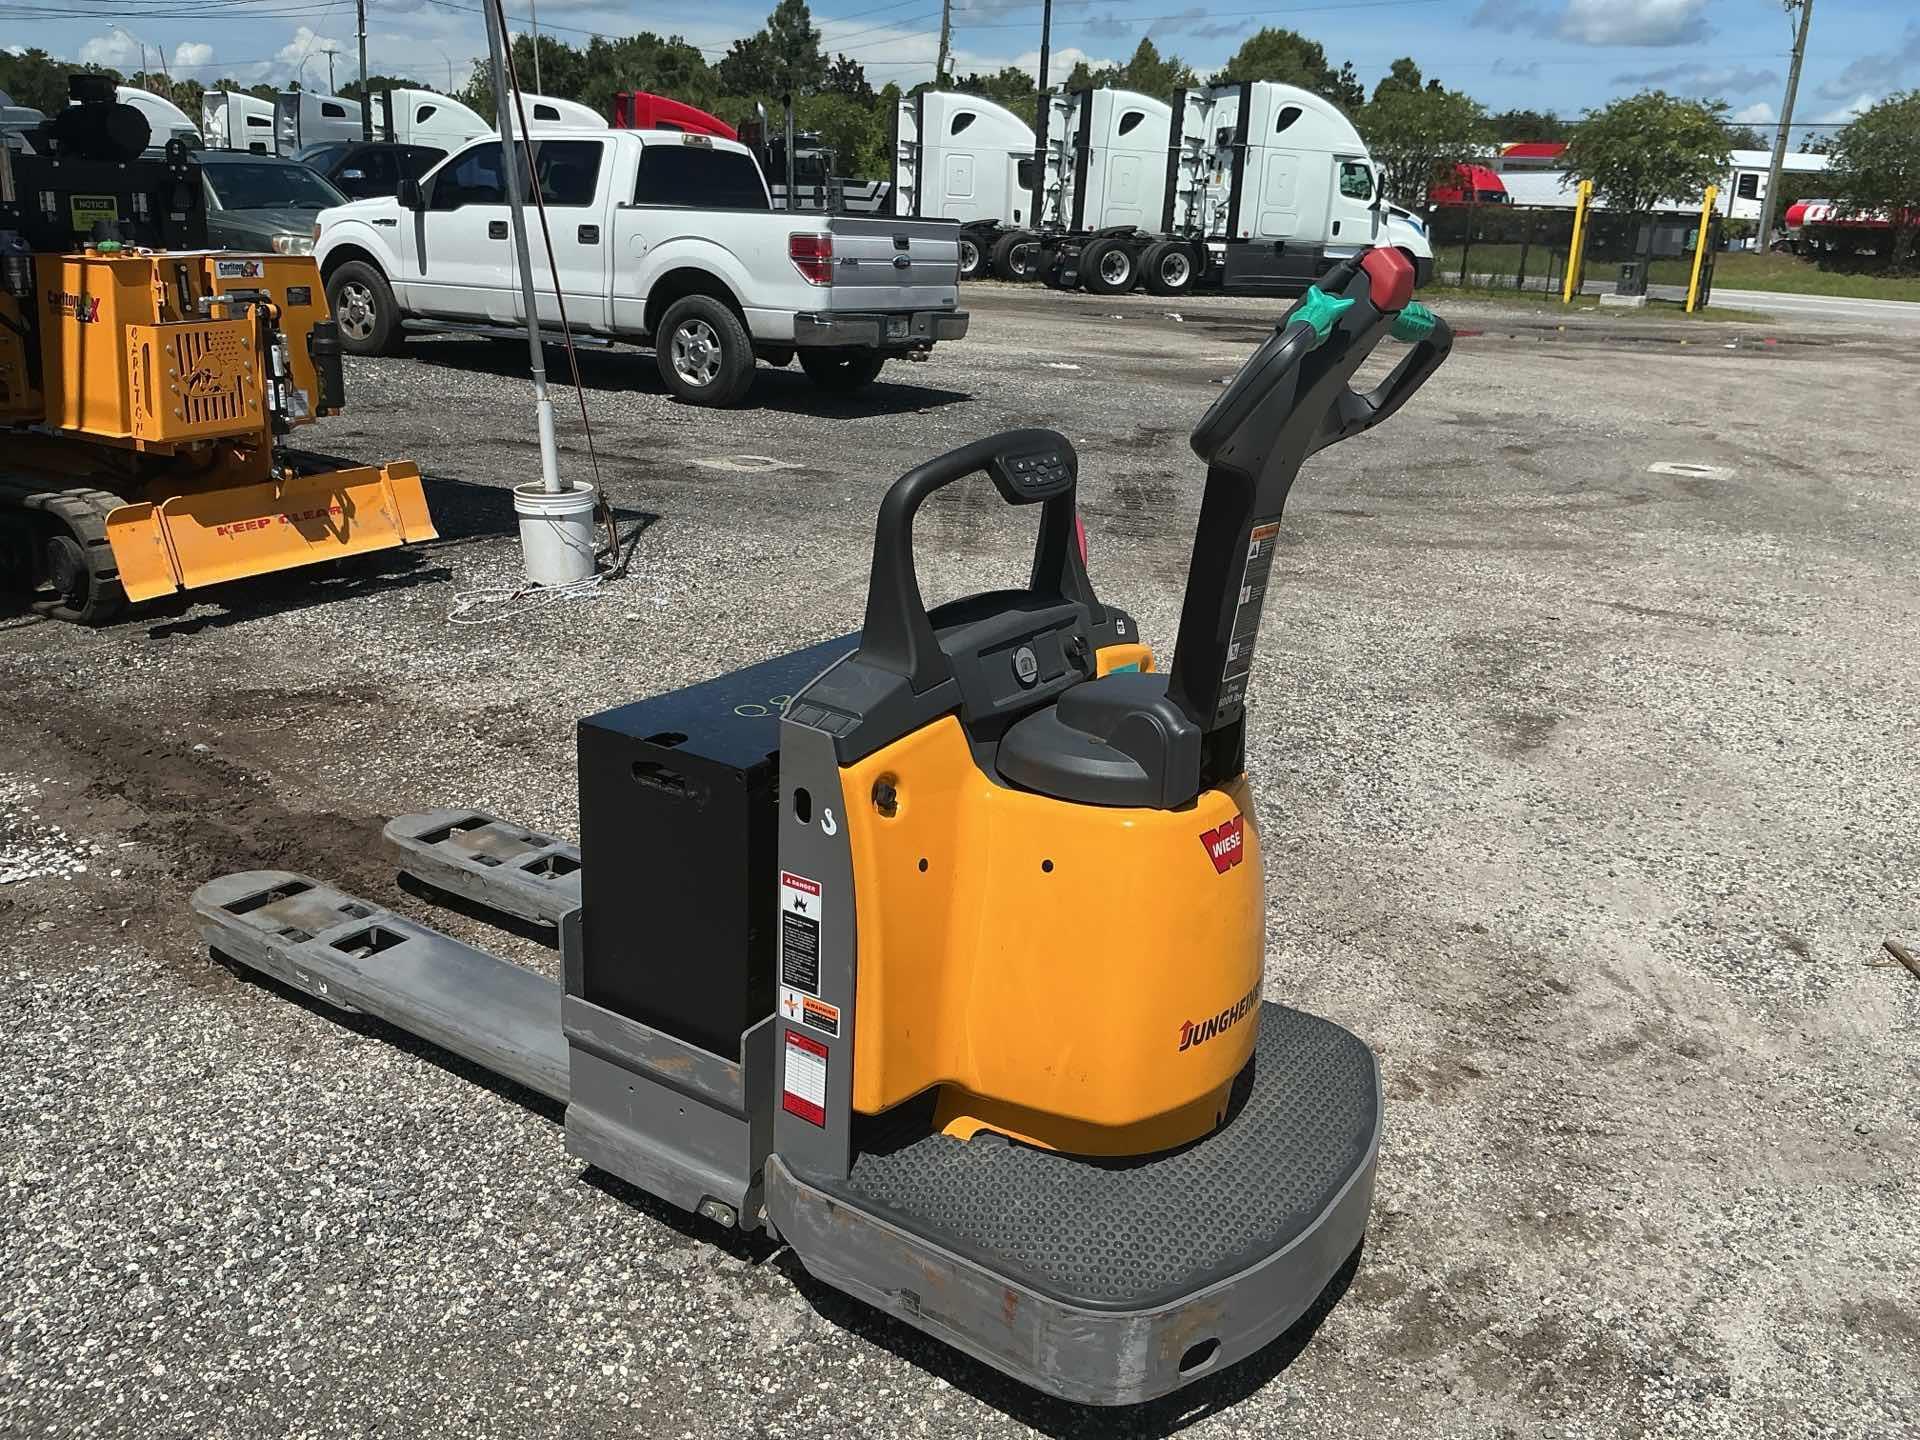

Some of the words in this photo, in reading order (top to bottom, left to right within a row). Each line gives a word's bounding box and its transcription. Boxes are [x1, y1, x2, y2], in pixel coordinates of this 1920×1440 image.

[79, 199, 110, 209] NOTICE
[130, 326, 144, 436] CARLTON
[216, 518, 271, 537] KEEP
[279, 505, 341, 525] CLEAR
[1212, 831, 1241, 858] WIESE
[791, 879, 816, 892] DANGER
[810, 1003, 836, 1017] WARNING
[1178, 978, 1261, 1052] JUNGHEIN
